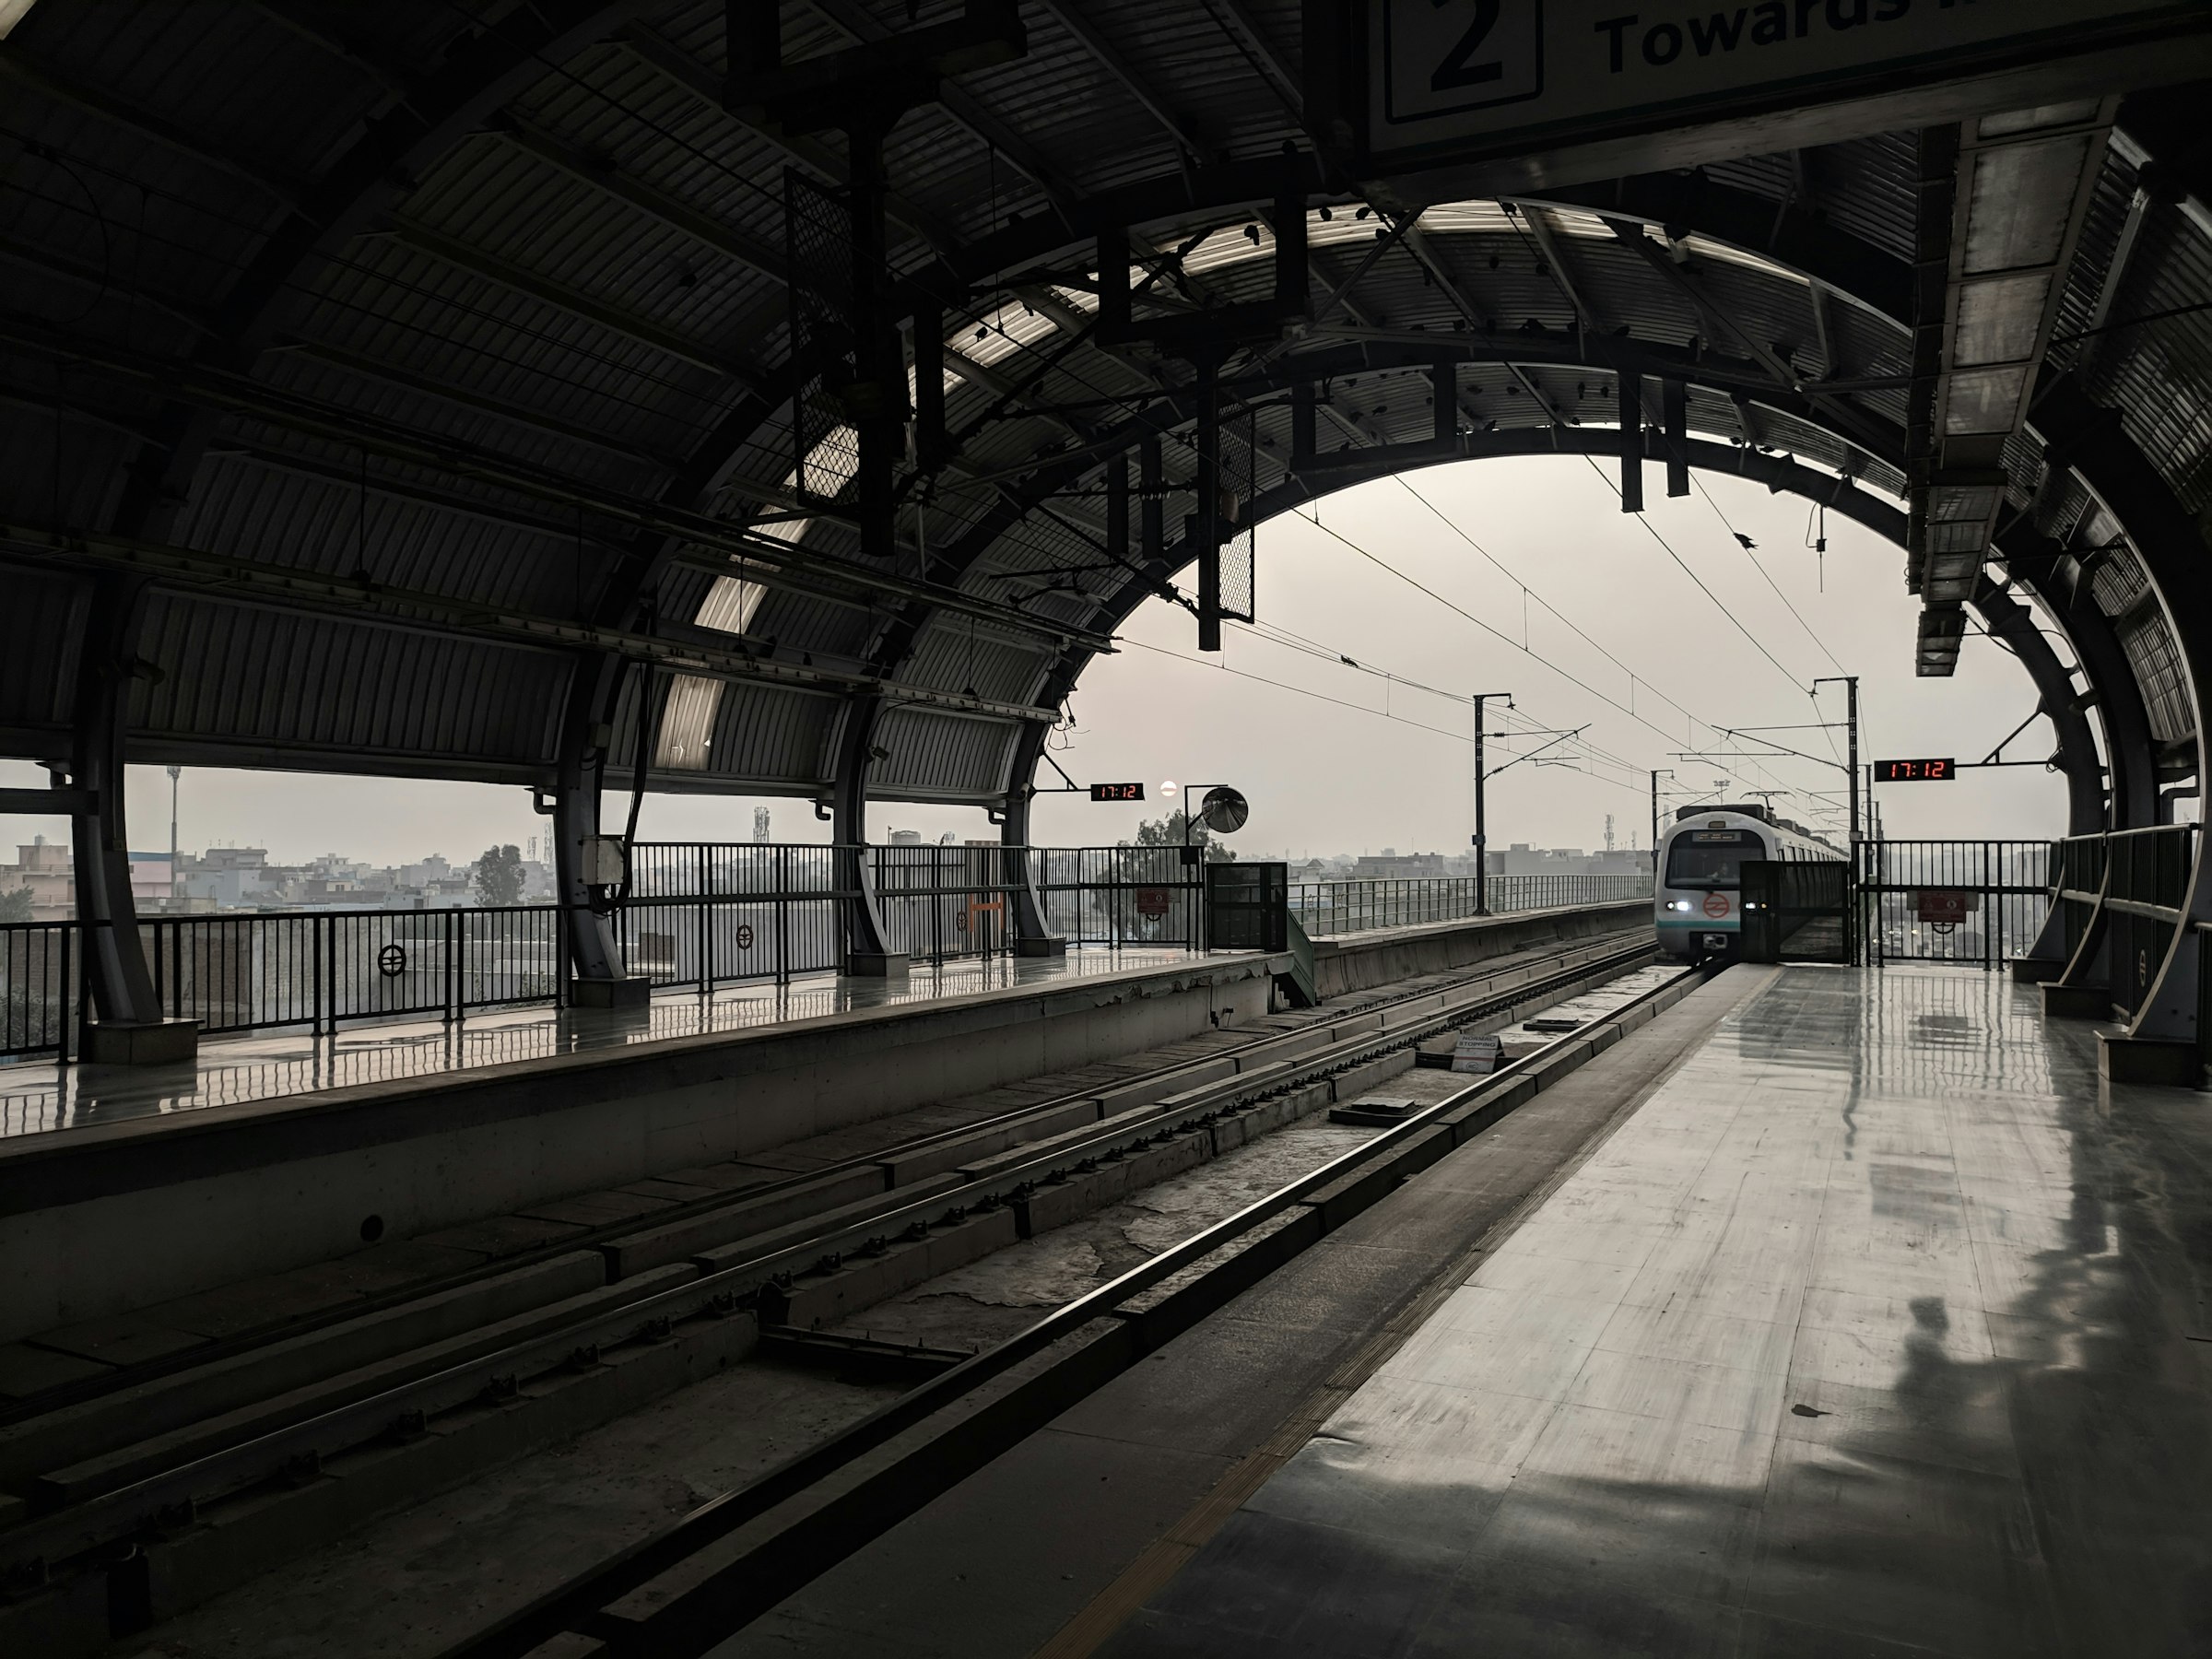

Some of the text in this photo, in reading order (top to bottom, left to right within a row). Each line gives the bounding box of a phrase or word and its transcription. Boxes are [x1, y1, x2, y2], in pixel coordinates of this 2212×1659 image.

[1430, 0, 1502, 92] 2
[1891, 761, 1945, 778] 17:12
[1101, 784, 1136, 798] 17:12
